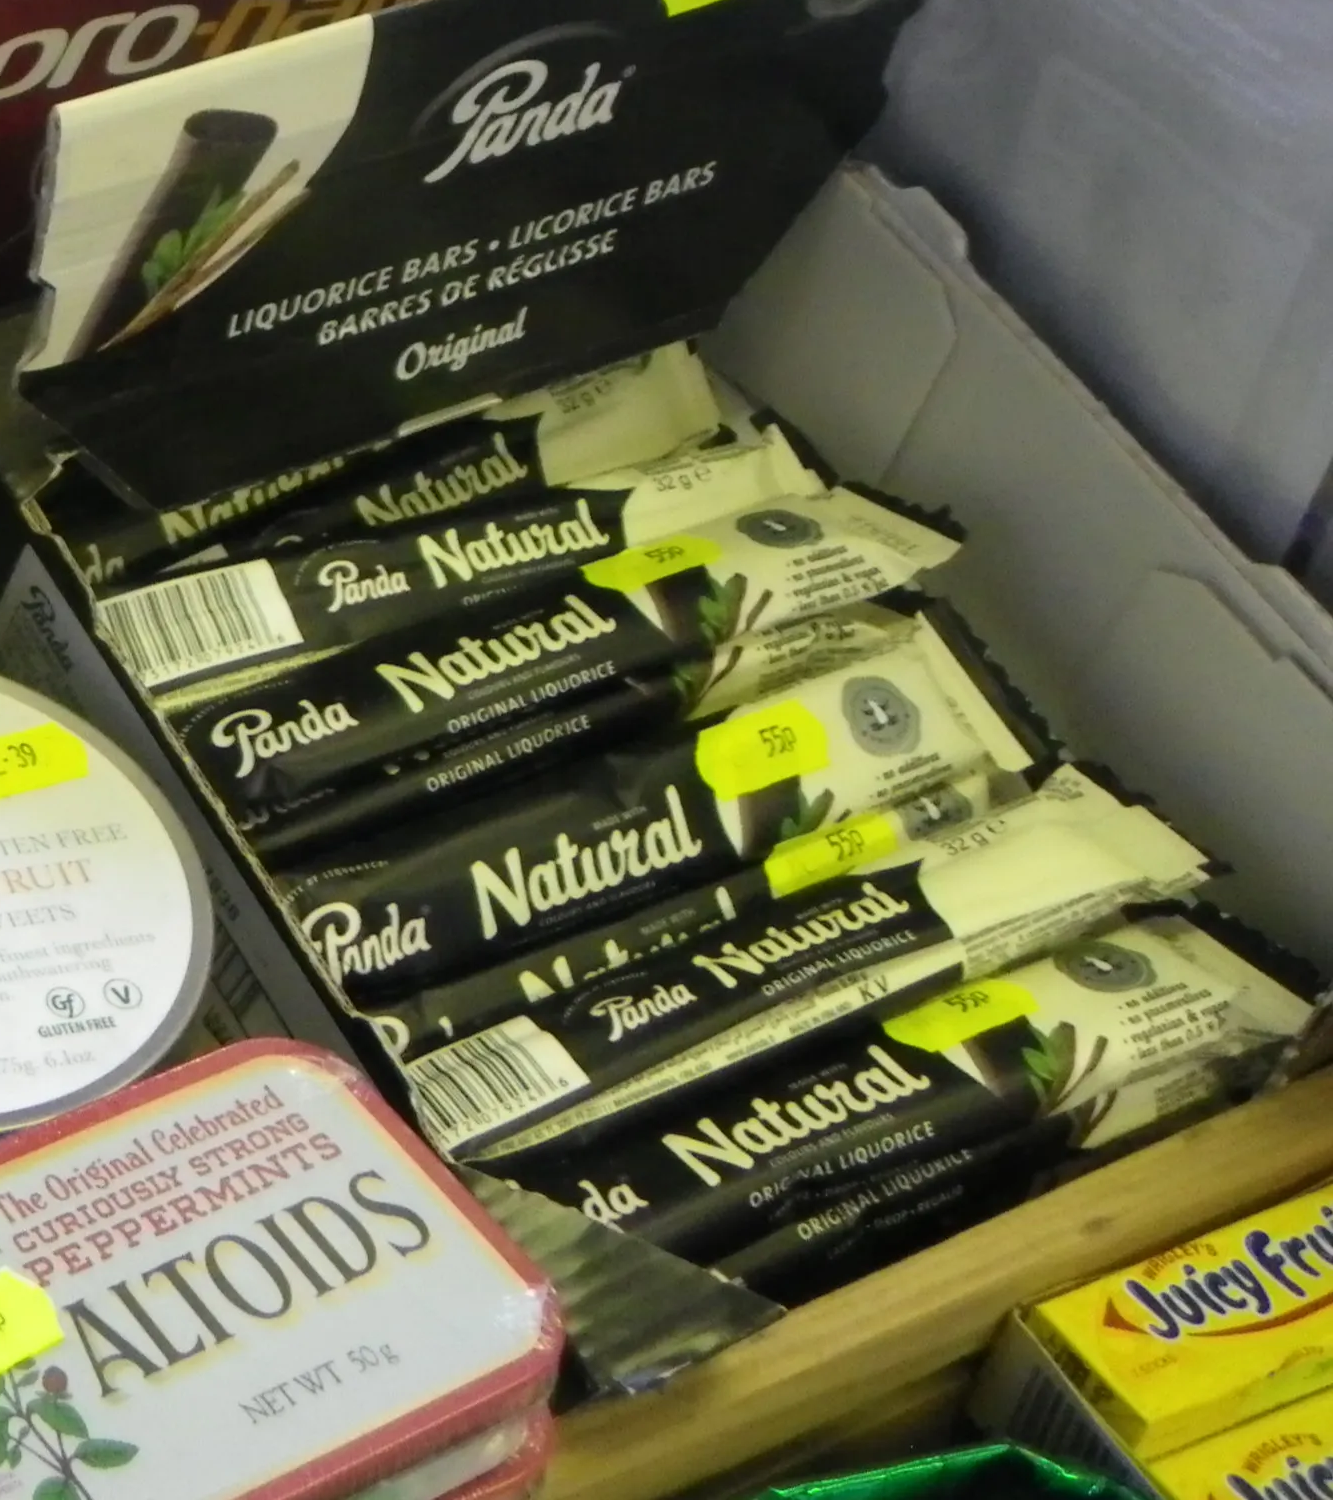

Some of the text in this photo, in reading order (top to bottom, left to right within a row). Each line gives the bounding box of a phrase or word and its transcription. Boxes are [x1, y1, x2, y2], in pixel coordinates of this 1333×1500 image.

[422, 58, 623, 185] Panda
[226, 161, 718, 341] LIQUORICE BARS LICORICE BARS
[317, 228, 620, 347] BARRES DE RÉGLISSE
[394, 307, 528, 382] Original
[356, 431, 529, 529] Natural
[317, 497, 611, 614] Panda Natural
[21, 584, 75, 674] Panda
[210, 699, 361, 779] Panda
[375, 594, 618, 715] Natural
[447, 660, 618, 735] ORIGINAL LIQUORICE
[426, 715, 592, 793] ORIGINAL LIQUORICE
[759, 725, 797, 758] 55p
[56, 823, 129, 850] FREE
[825, 828, 866, 862] 55p
[301, 901, 433, 989] Panda
[469, 784, 703, 941] Natural
[589, 982, 699, 1043] Panda
[691, 881, 911, 990] Natural
[761, 929, 919, 998] ORIGINAL LIQUORICE
[45, 1138, 154, 1202] Original
[153, 1083, 286, 1155] Celebrated
[661, 1043, 931, 1190] Natural
[838, 1118, 937, 1172] LIQUORICE
[13, 1111, 311, 1252] CURIOUSLY STRONG
[17, 1132, 343, 1289] PEPPERMINTS
[797, 1148, 974, 1243] ORIGINAL LIQUORICE
[63, 1168, 432, 1399] ALTOIDS
[1125, 1259, 1273, 1340] Juicy
[1242, 1432, 1323, 1475] WRIGLEY'S
